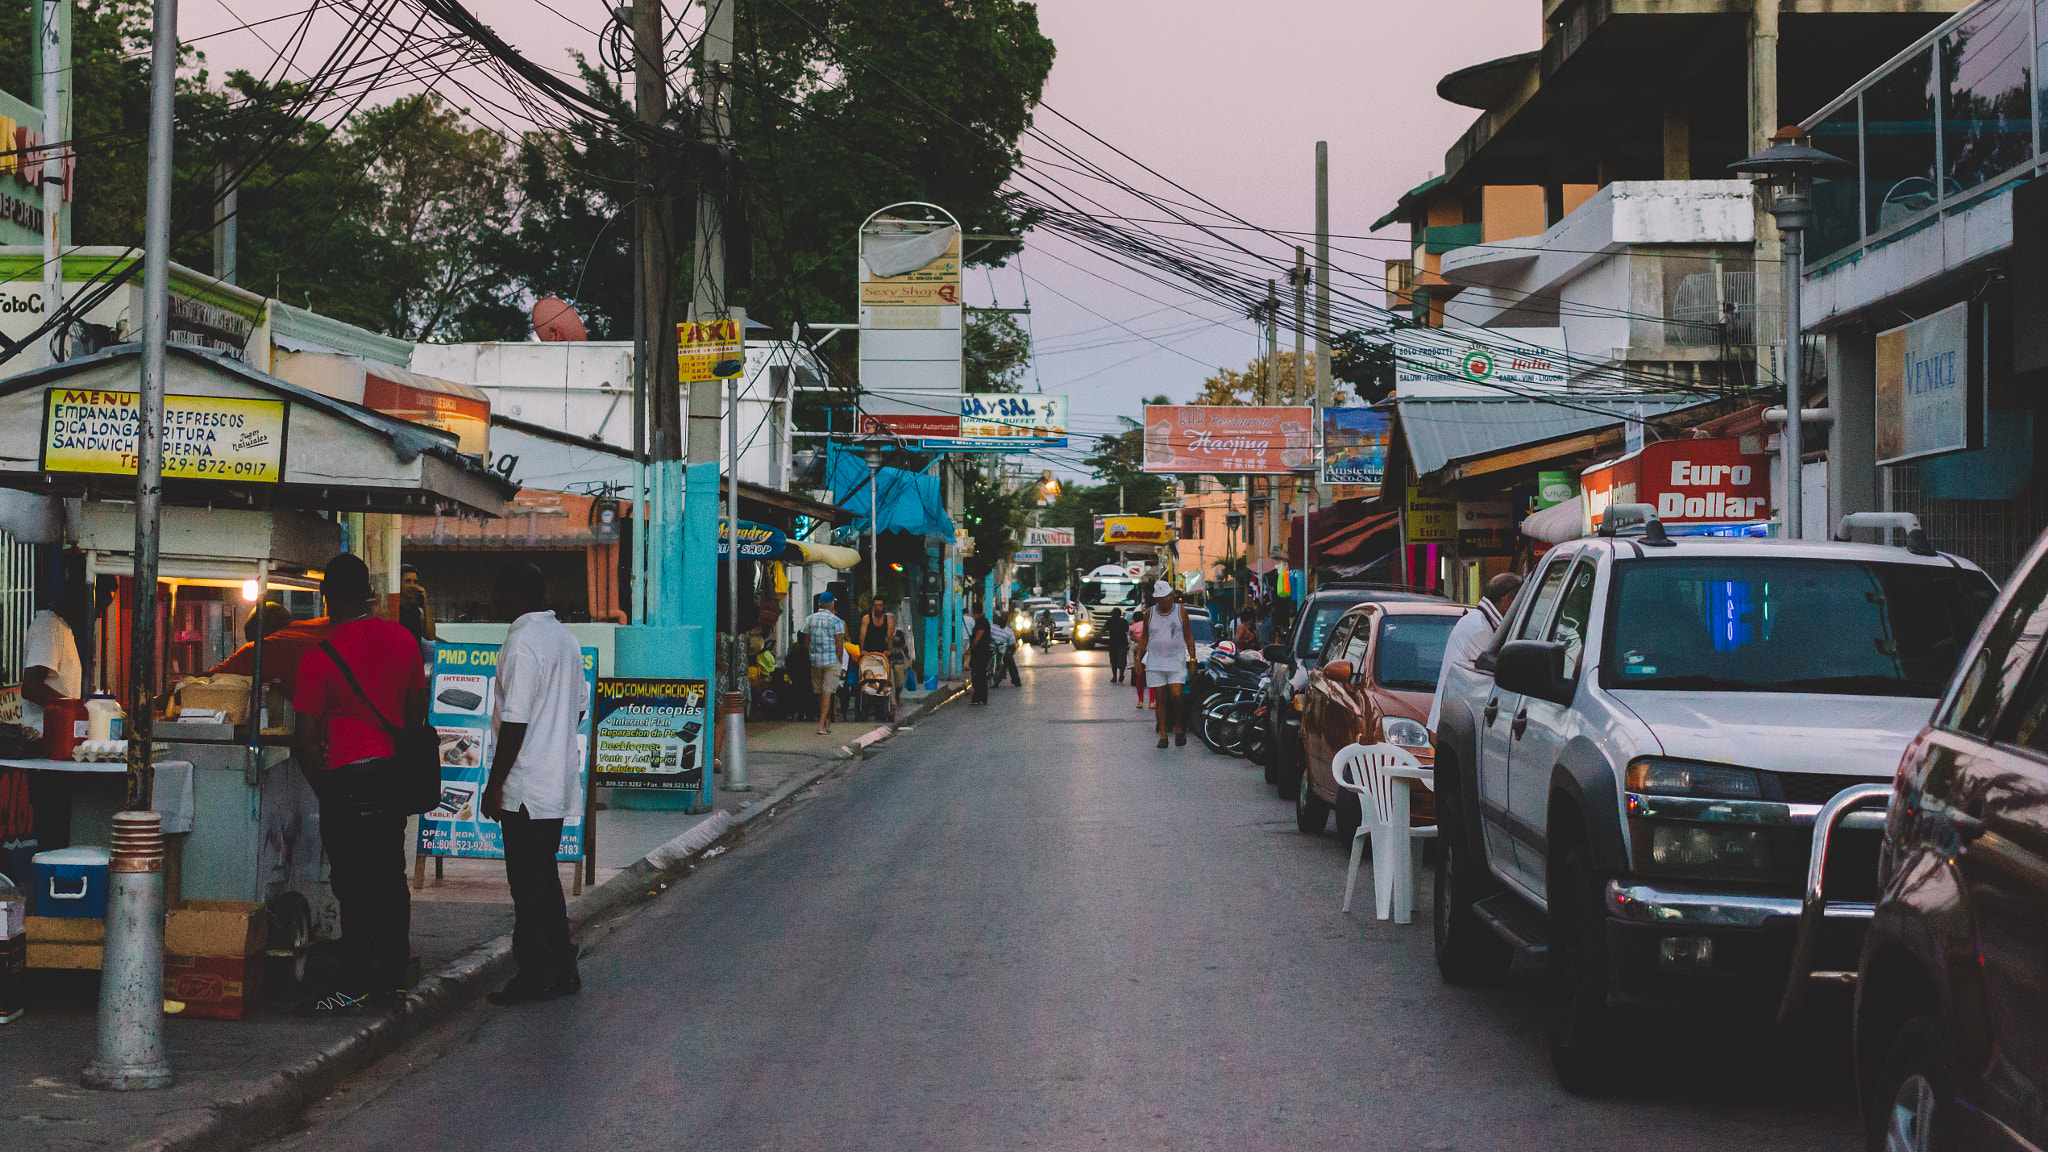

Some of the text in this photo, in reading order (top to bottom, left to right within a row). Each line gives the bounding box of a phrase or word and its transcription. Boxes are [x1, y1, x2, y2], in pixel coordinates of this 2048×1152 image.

[865, 286, 938, 298] Sexy Shop
[677, 322, 736, 344] TAXI
[1905, 350, 1956, 396] VENICE
[63, 391, 132, 406] MENU
[998, 398, 1036, 416] SAL
[165, 410, 244, 428] REFRESCOS
[1177, 407, 1280, 428] BAR Restaurant
[162, 427, 216, 442] RITURA
[922, 423, 958, 431] Autorizado
[52, 434, 134, 452] SANDWICH
[232, 434, 268, 451] Naturales
[1183, 429, 1269, 457] Haojing
[120, 454, 139, 469] TE
[1326, 464, 1384, 475] Amsterda
[1670, 460, 1752, 486] Euro
[1658, 492, 1766, 518] Dollar
[1425, 514, 1441, 524] US
[1419, 527, 1447, 537] Euro
[740, 543, 773, 555] SHOP
[437, 649, 468, 665] PMD
[627, 703, 702, 718] foto copias
[612, 717, 649, 727] Internet
[600, 728, 678, 738] Reparacion de PC
[601, 741, 662, 753] Desbloqueo
[428, 811, 455, 819] TABLET
[422, 829, 448, 838] OPEN
